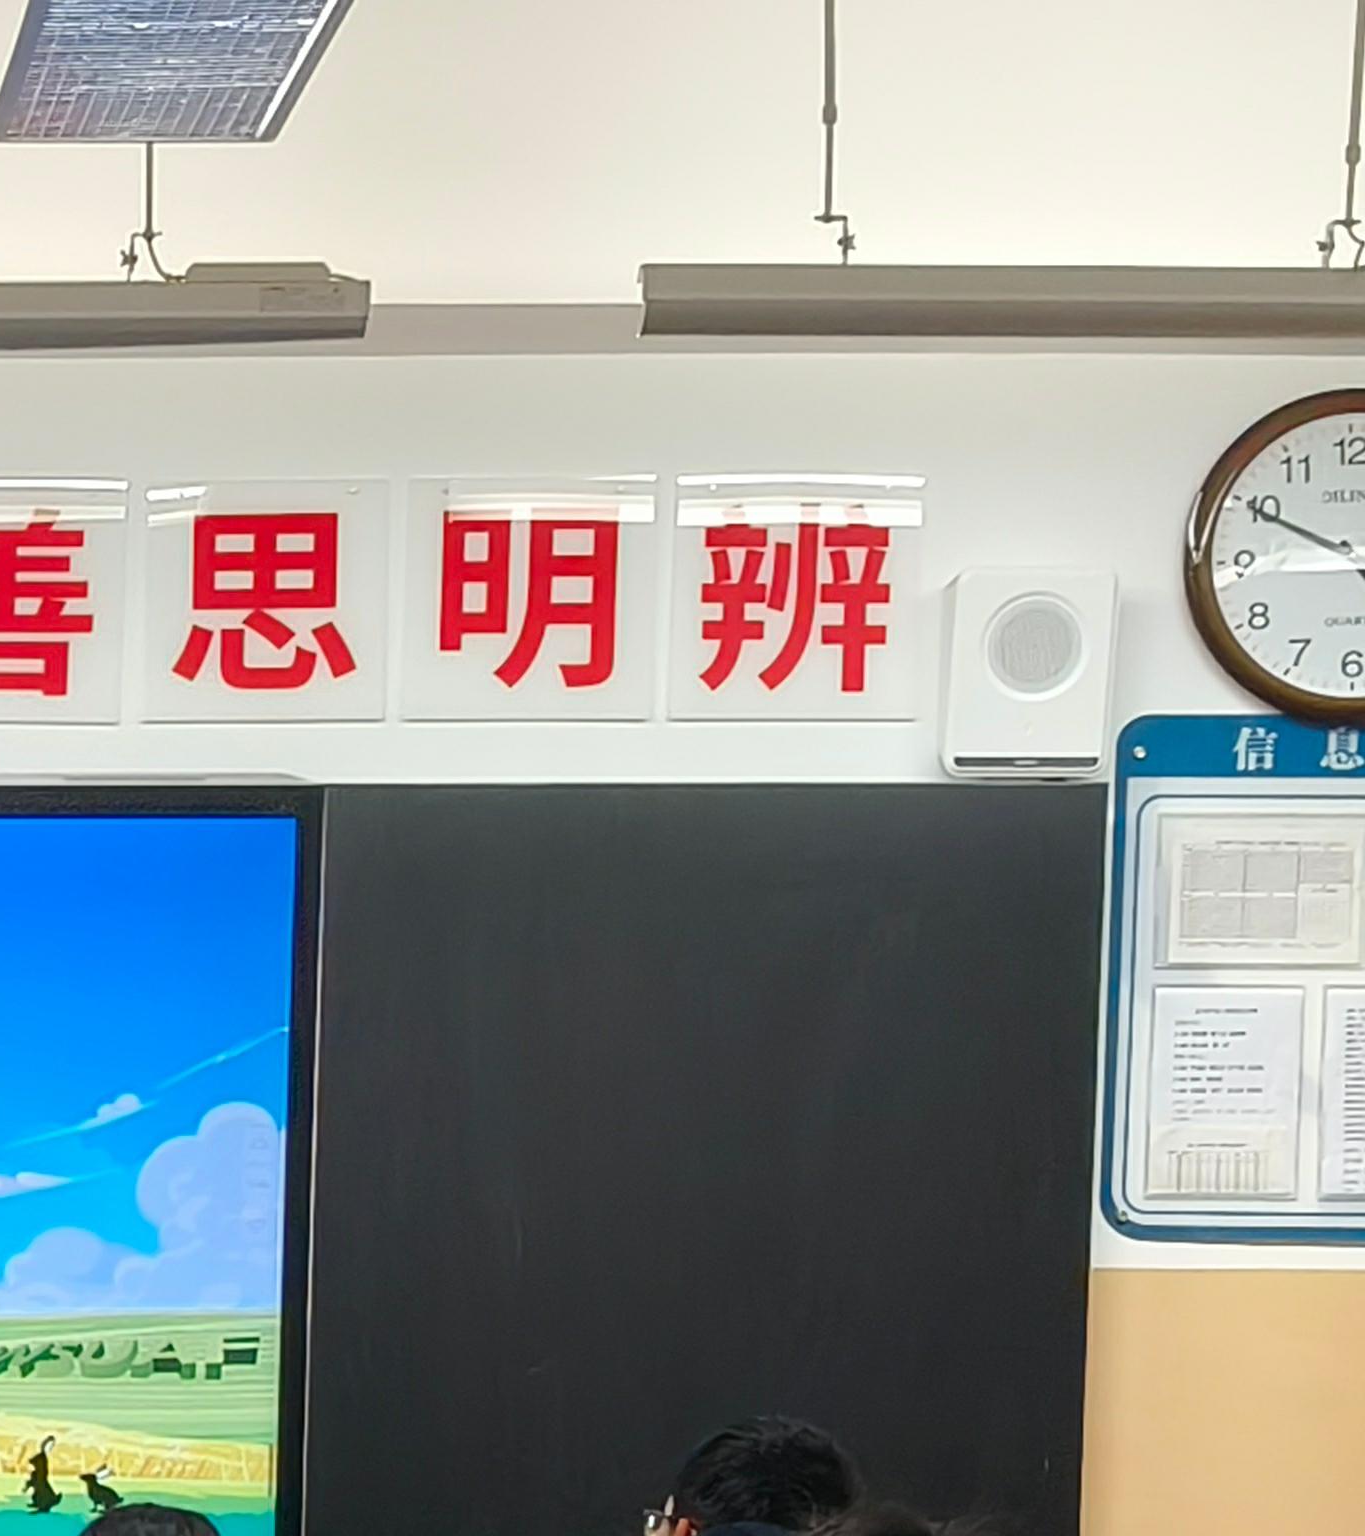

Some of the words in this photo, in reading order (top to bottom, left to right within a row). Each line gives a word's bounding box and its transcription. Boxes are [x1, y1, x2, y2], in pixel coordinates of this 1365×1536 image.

[1280, 454, 1312, 484] 11
[1250, 494, 1282, 524] 10
[1233, 549, 1257, 579] 9
[1247, 601, 1271, 631] 8
[1287, 638, 1312, 668] 7
[1340, 650, 1364, 678] 6
